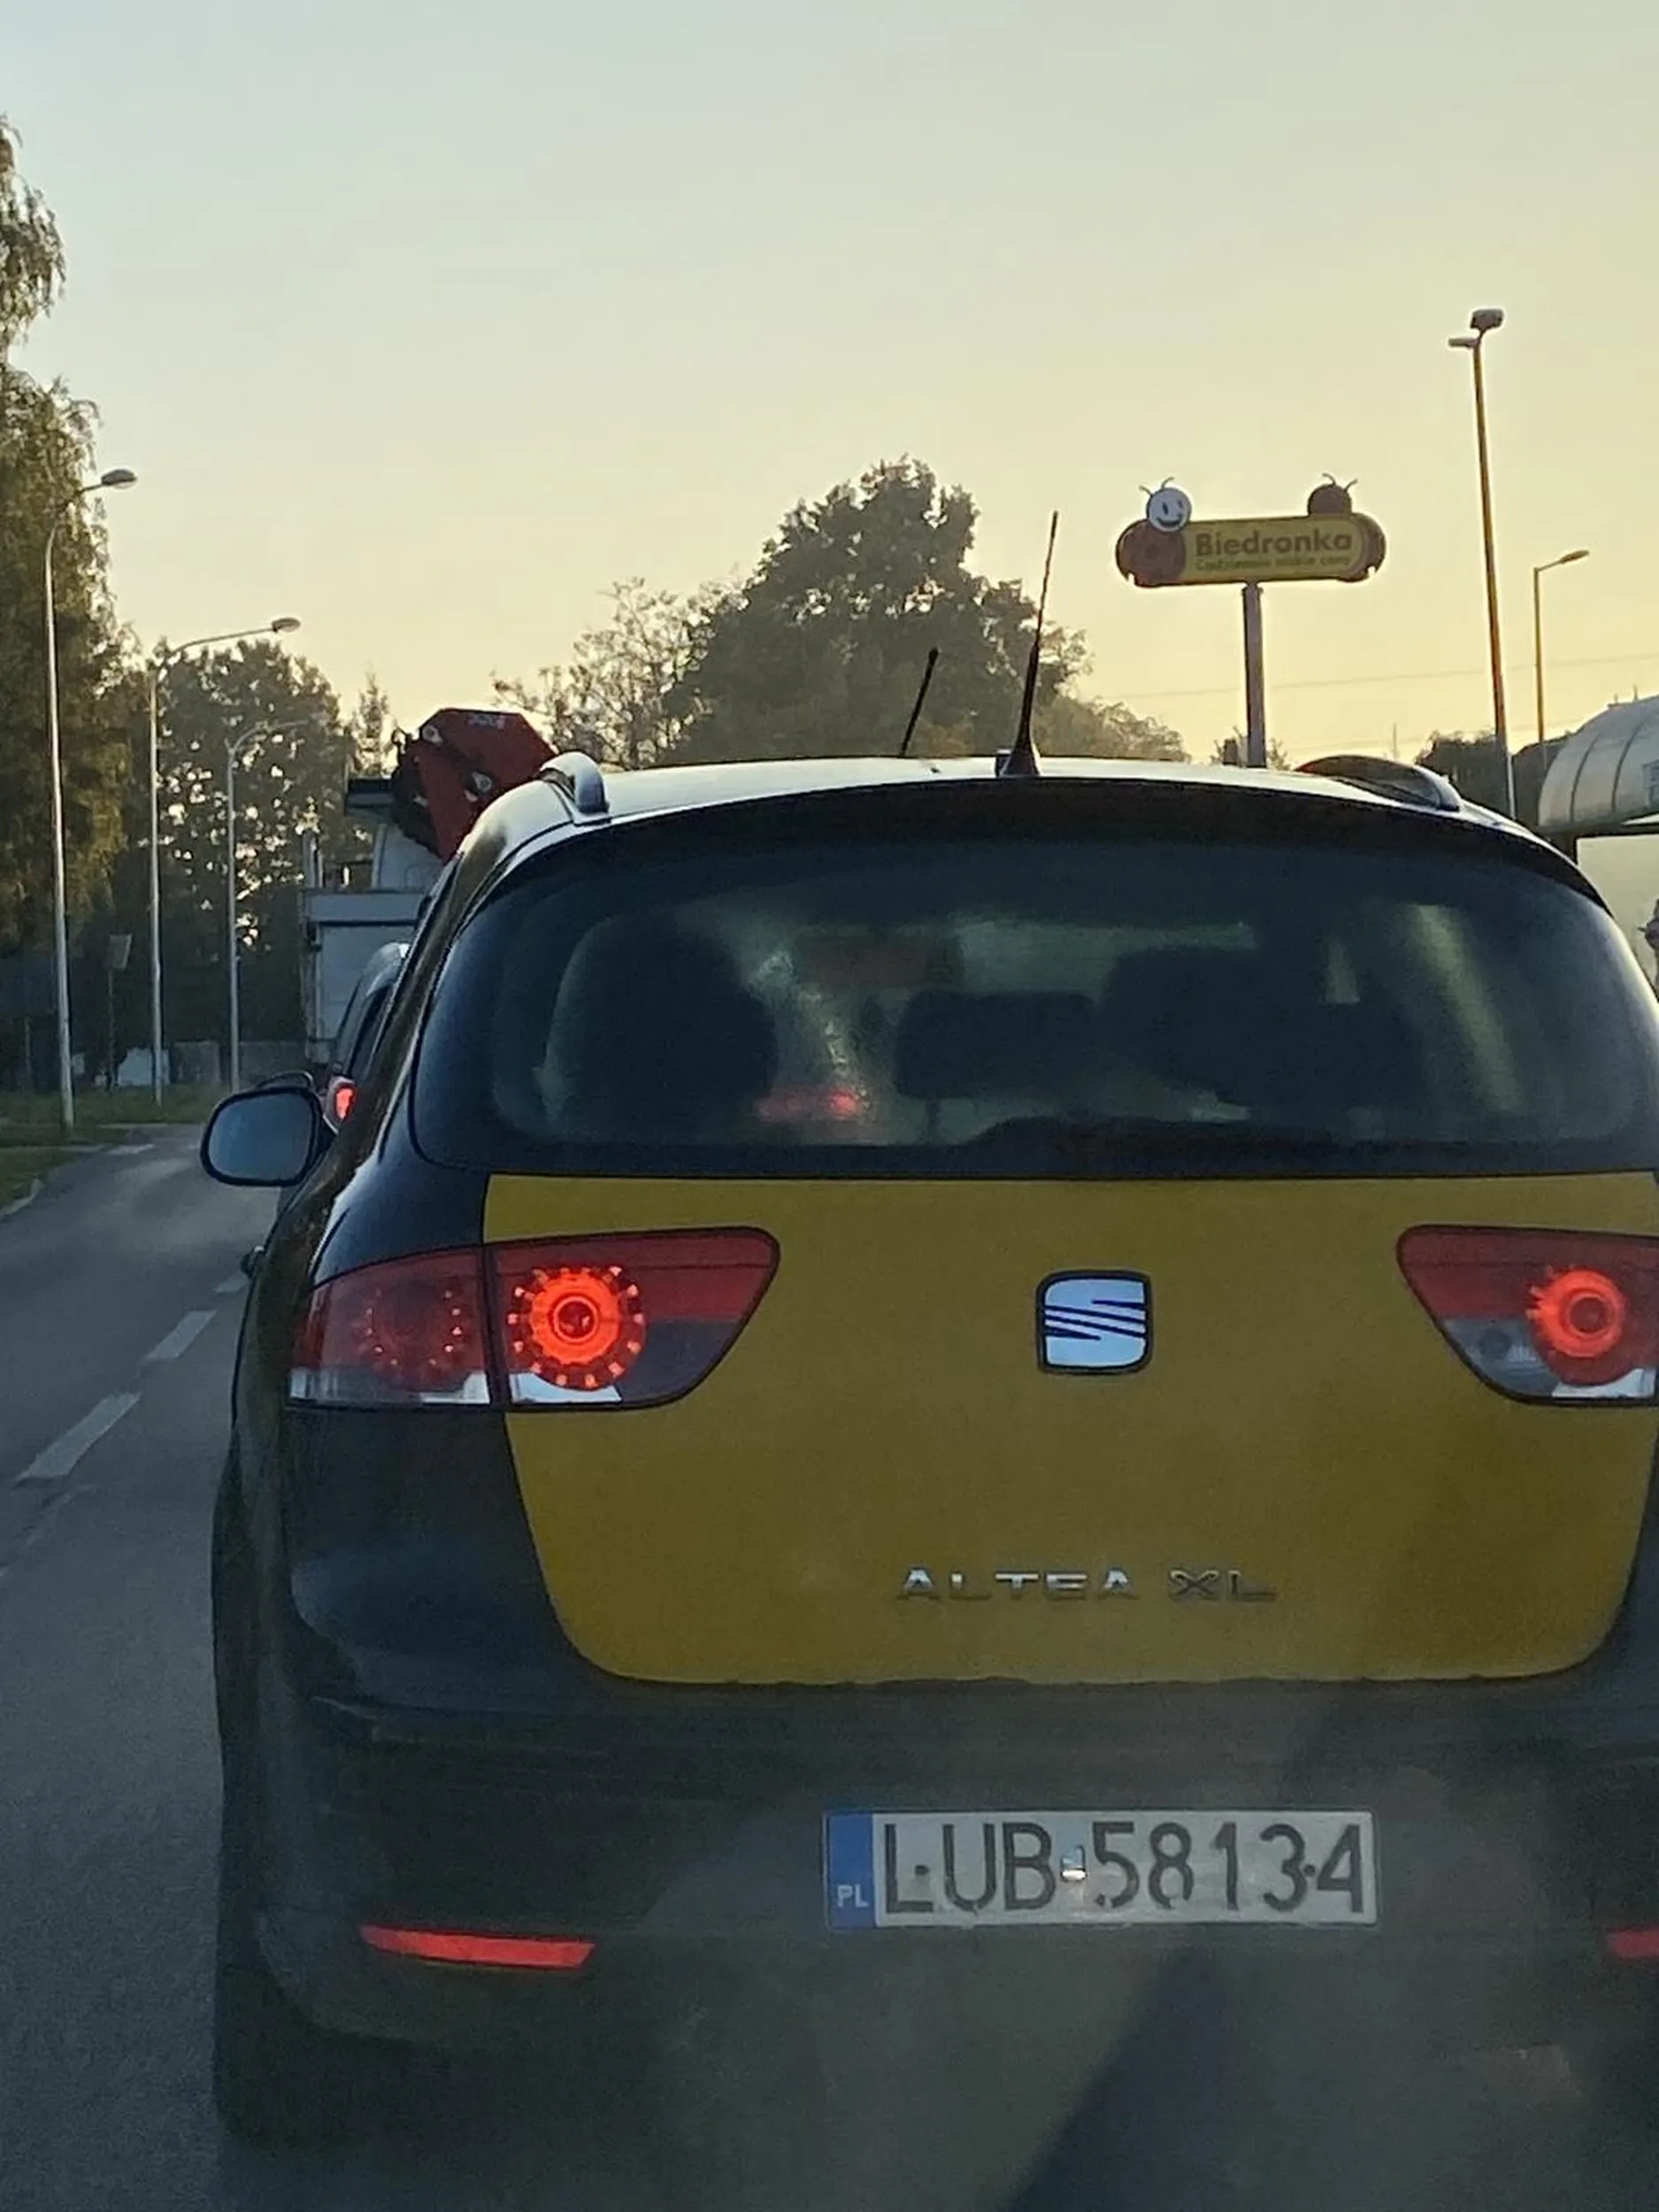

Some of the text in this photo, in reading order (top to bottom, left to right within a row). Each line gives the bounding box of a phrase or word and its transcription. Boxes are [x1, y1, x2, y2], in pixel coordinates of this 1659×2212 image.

[1195, 529, 1352, 557] Biedronka
[897, 1569, 1277, 1600] ALTEA XL
[884, 1821, 1363, 1913] LUB 58134
[837, 1884, 869, 1908] PL
